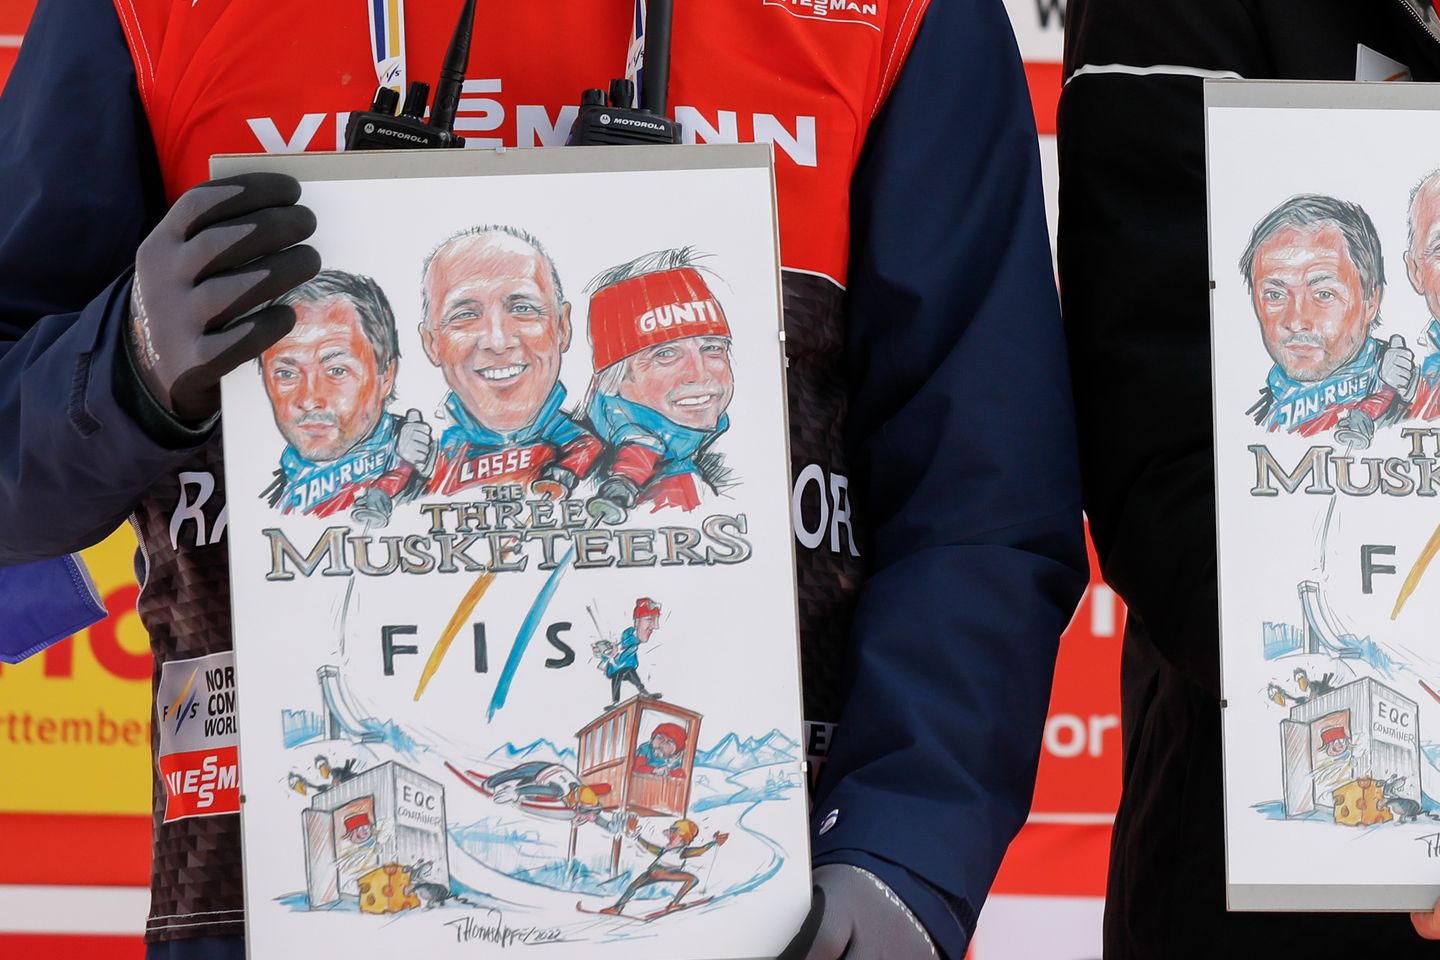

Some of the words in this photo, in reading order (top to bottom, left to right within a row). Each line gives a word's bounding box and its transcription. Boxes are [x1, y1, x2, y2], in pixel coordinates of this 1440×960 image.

[376, 127, 429, 145] MOTOROLA
[613, 117, 666, 132] MOTOROLA
[639, 300, 719, 333] GUNTI
[459, 449, 532, 482] LASSE
[482, 484, 524, 502] THE
[421, 499, 591, 534] THREE
[262, 513, 752, 581] MUSKETEERS
[166, 756, 240, 808] VIESSM
